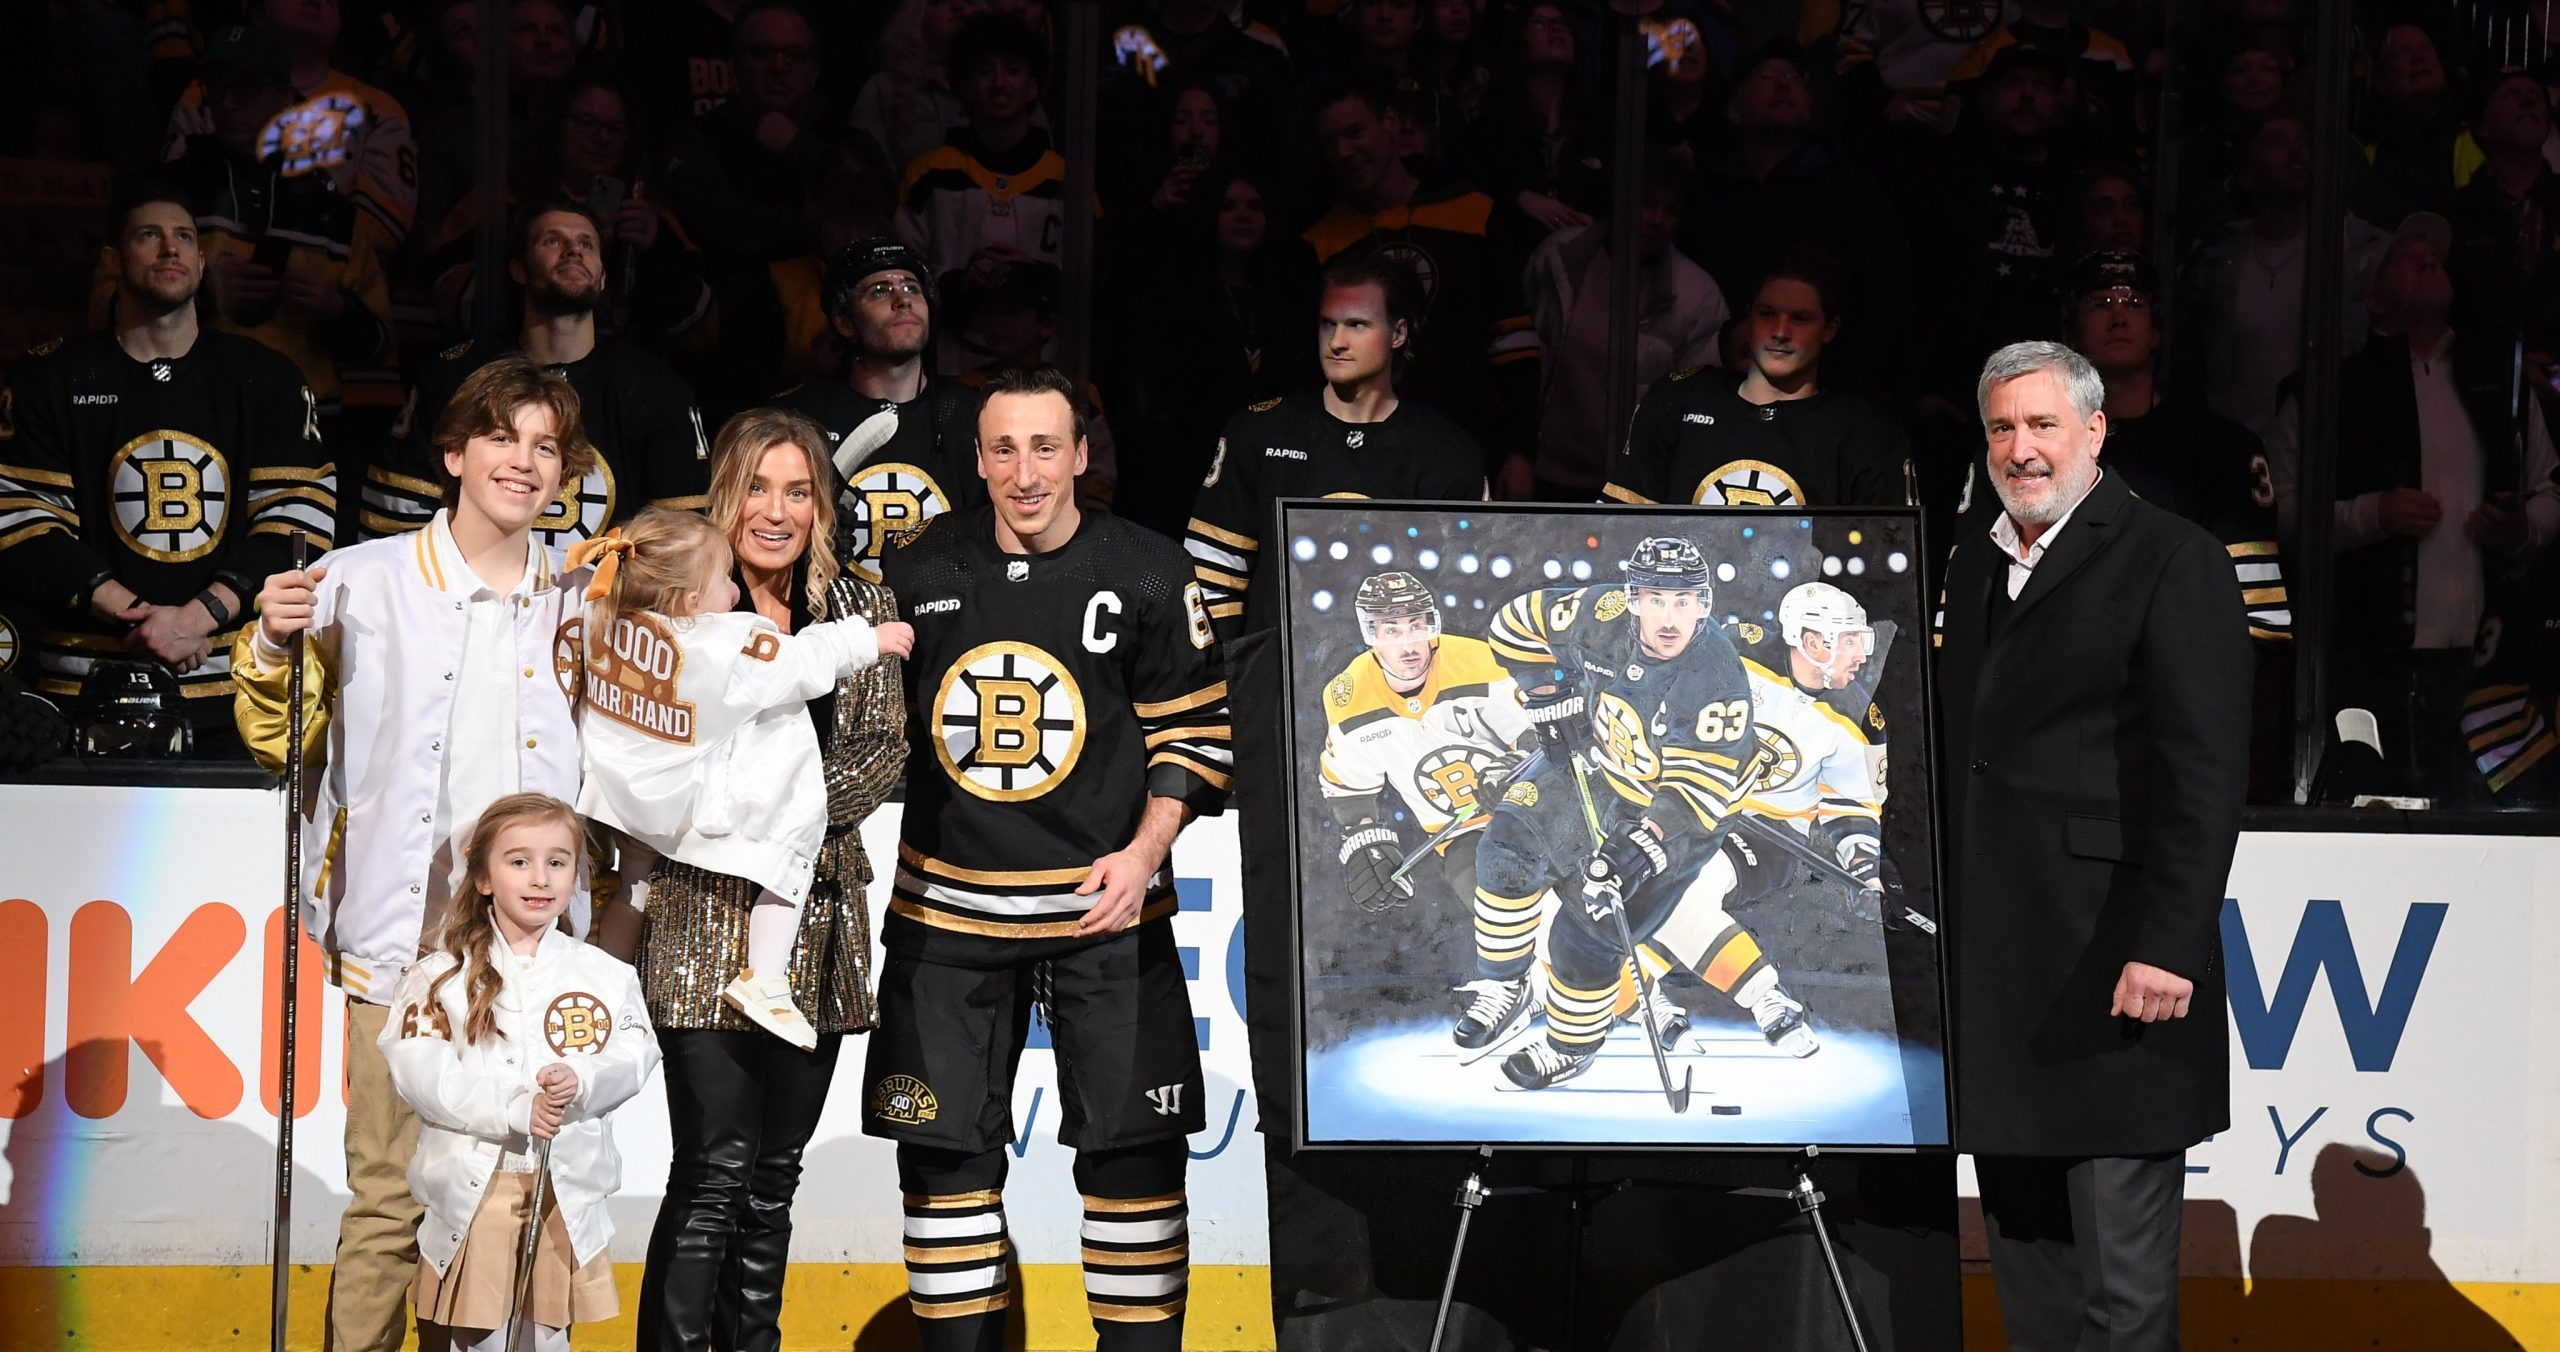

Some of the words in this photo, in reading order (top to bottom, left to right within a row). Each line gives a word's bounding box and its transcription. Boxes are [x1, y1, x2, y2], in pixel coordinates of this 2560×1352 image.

[142, 459, 205, 532] B
[2250, 455, 2274, 508] 3
[1081, 591, 1123, 654] C
[130, 672, 151, 684] 13
[587, 670, 691, 738] MARCHAND
[976, 676, 1042, 766] B
[1695, 699, 1749, 743] 63
[892, 1095, 910, 1110] 100
